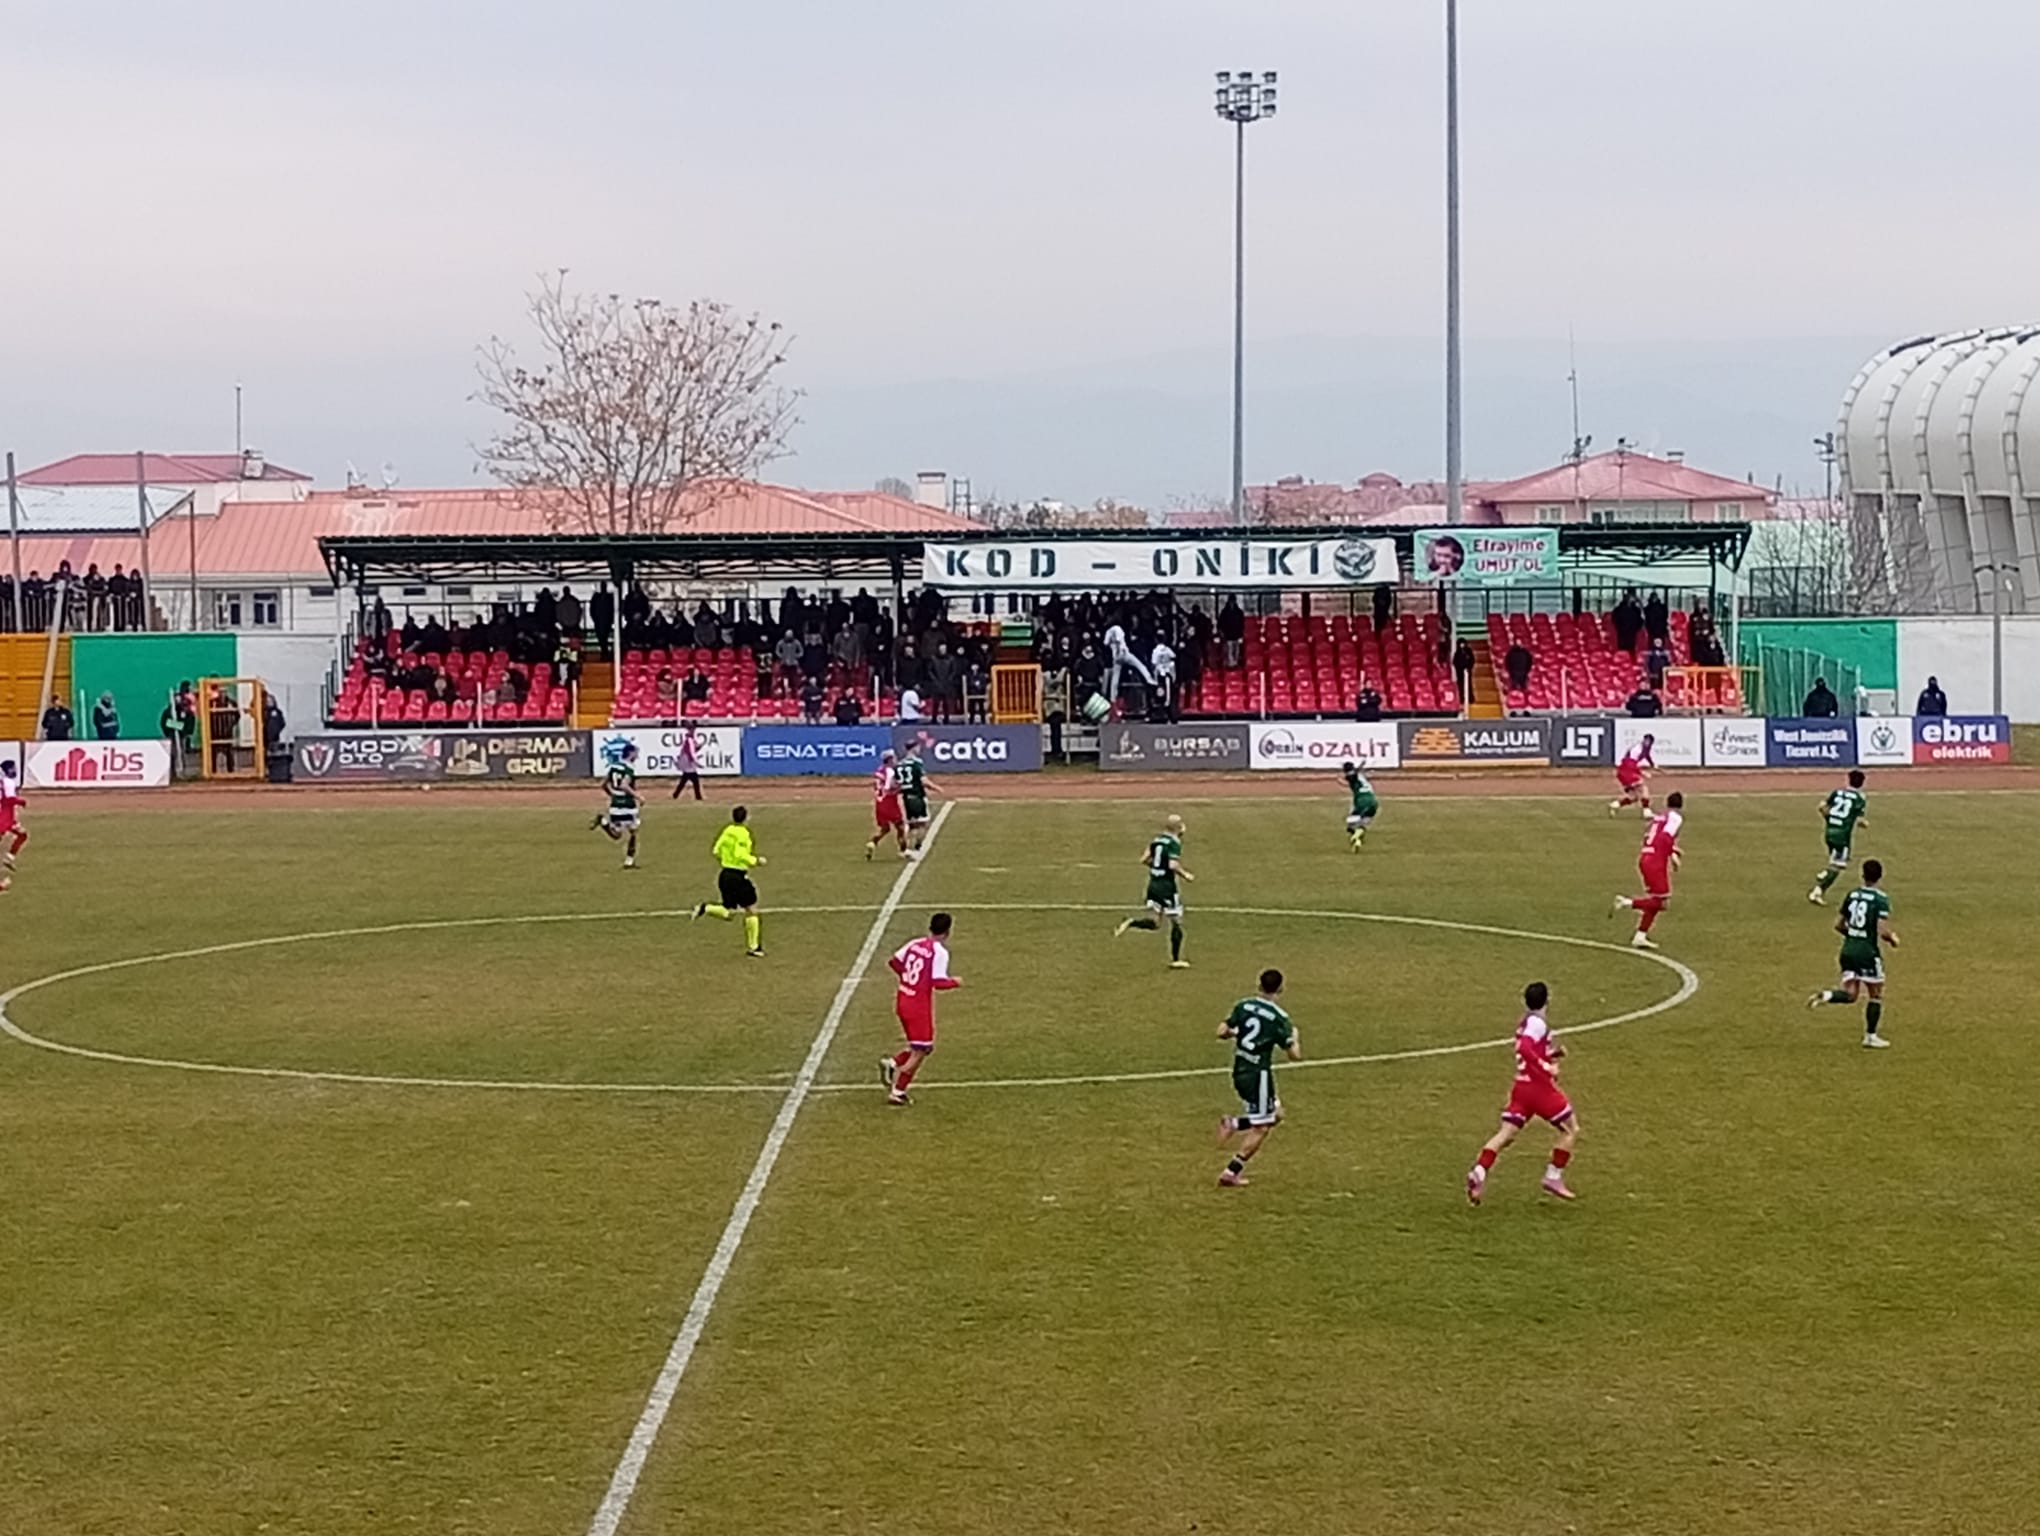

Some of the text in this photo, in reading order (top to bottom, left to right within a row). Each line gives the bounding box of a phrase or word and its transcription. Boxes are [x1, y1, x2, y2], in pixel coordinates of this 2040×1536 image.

[946, 548, 1056, 578] KOD
[1475, 558, 1544, 573] UMUT OL
[661, 732, 719, 748] CUDA
[1922, 719, 1997, 742] ebru
[338, 753, 384, 764] OTO
[757, 744, 876, 758] SENATECH
[934, 737, 1007, 760] cata
[1308, 738, 1391, 758] OZALİT
[1932, 745, 1993, 759] elektrik
[103, 749, 143, 772] ibs
[506, 758, 567, 774] GRUP
[1829, 796, 1852, 818] 23
[1848, 900, 1868, 928] 18
[1241, 1017, 1261, 1051] 2
